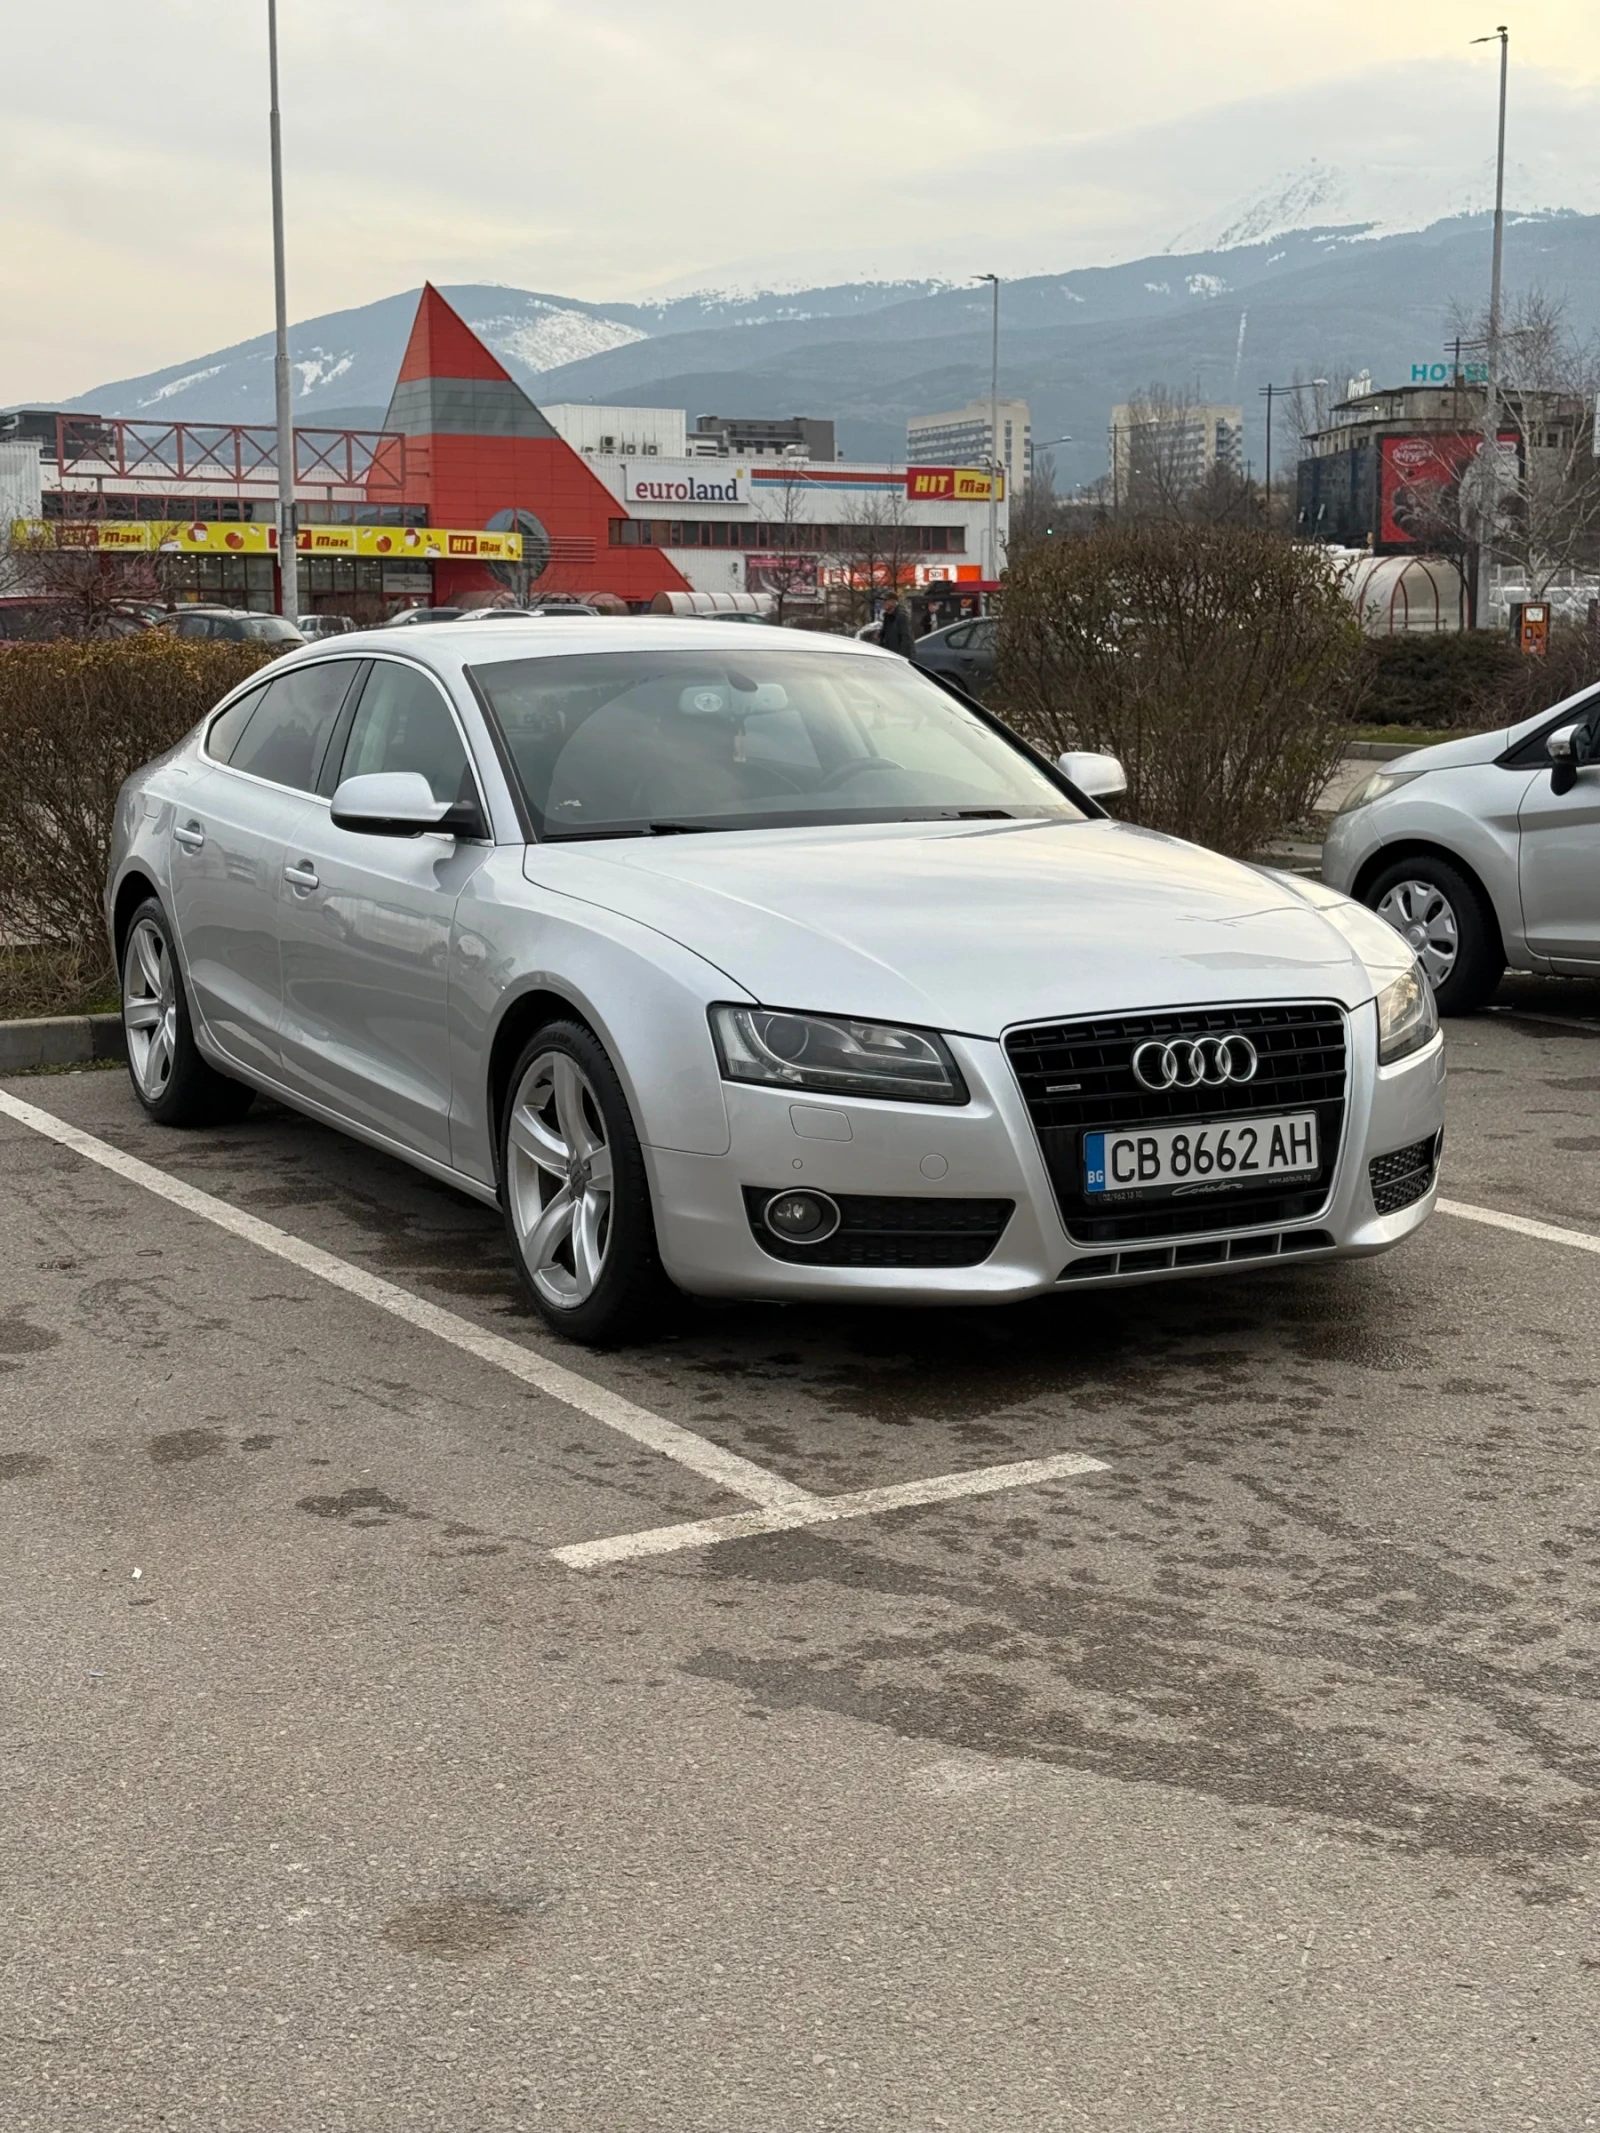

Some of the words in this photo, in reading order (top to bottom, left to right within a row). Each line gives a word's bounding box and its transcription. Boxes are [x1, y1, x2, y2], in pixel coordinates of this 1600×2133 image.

[635, 477, 739, 501] euroland
[915, 475, 950, 493] HIT
[104, 531, 142, 543] Max
[316, 536, 349, 547] Max
[452, 538, 475, 552] HIT
[1111, 1137, 1161, 1183] CB
[1170, 1127, 1259, 1177] 8662
[1268, 1121, 1313, 1168] AH
[1088, 1170, 1104, 1185] BG
